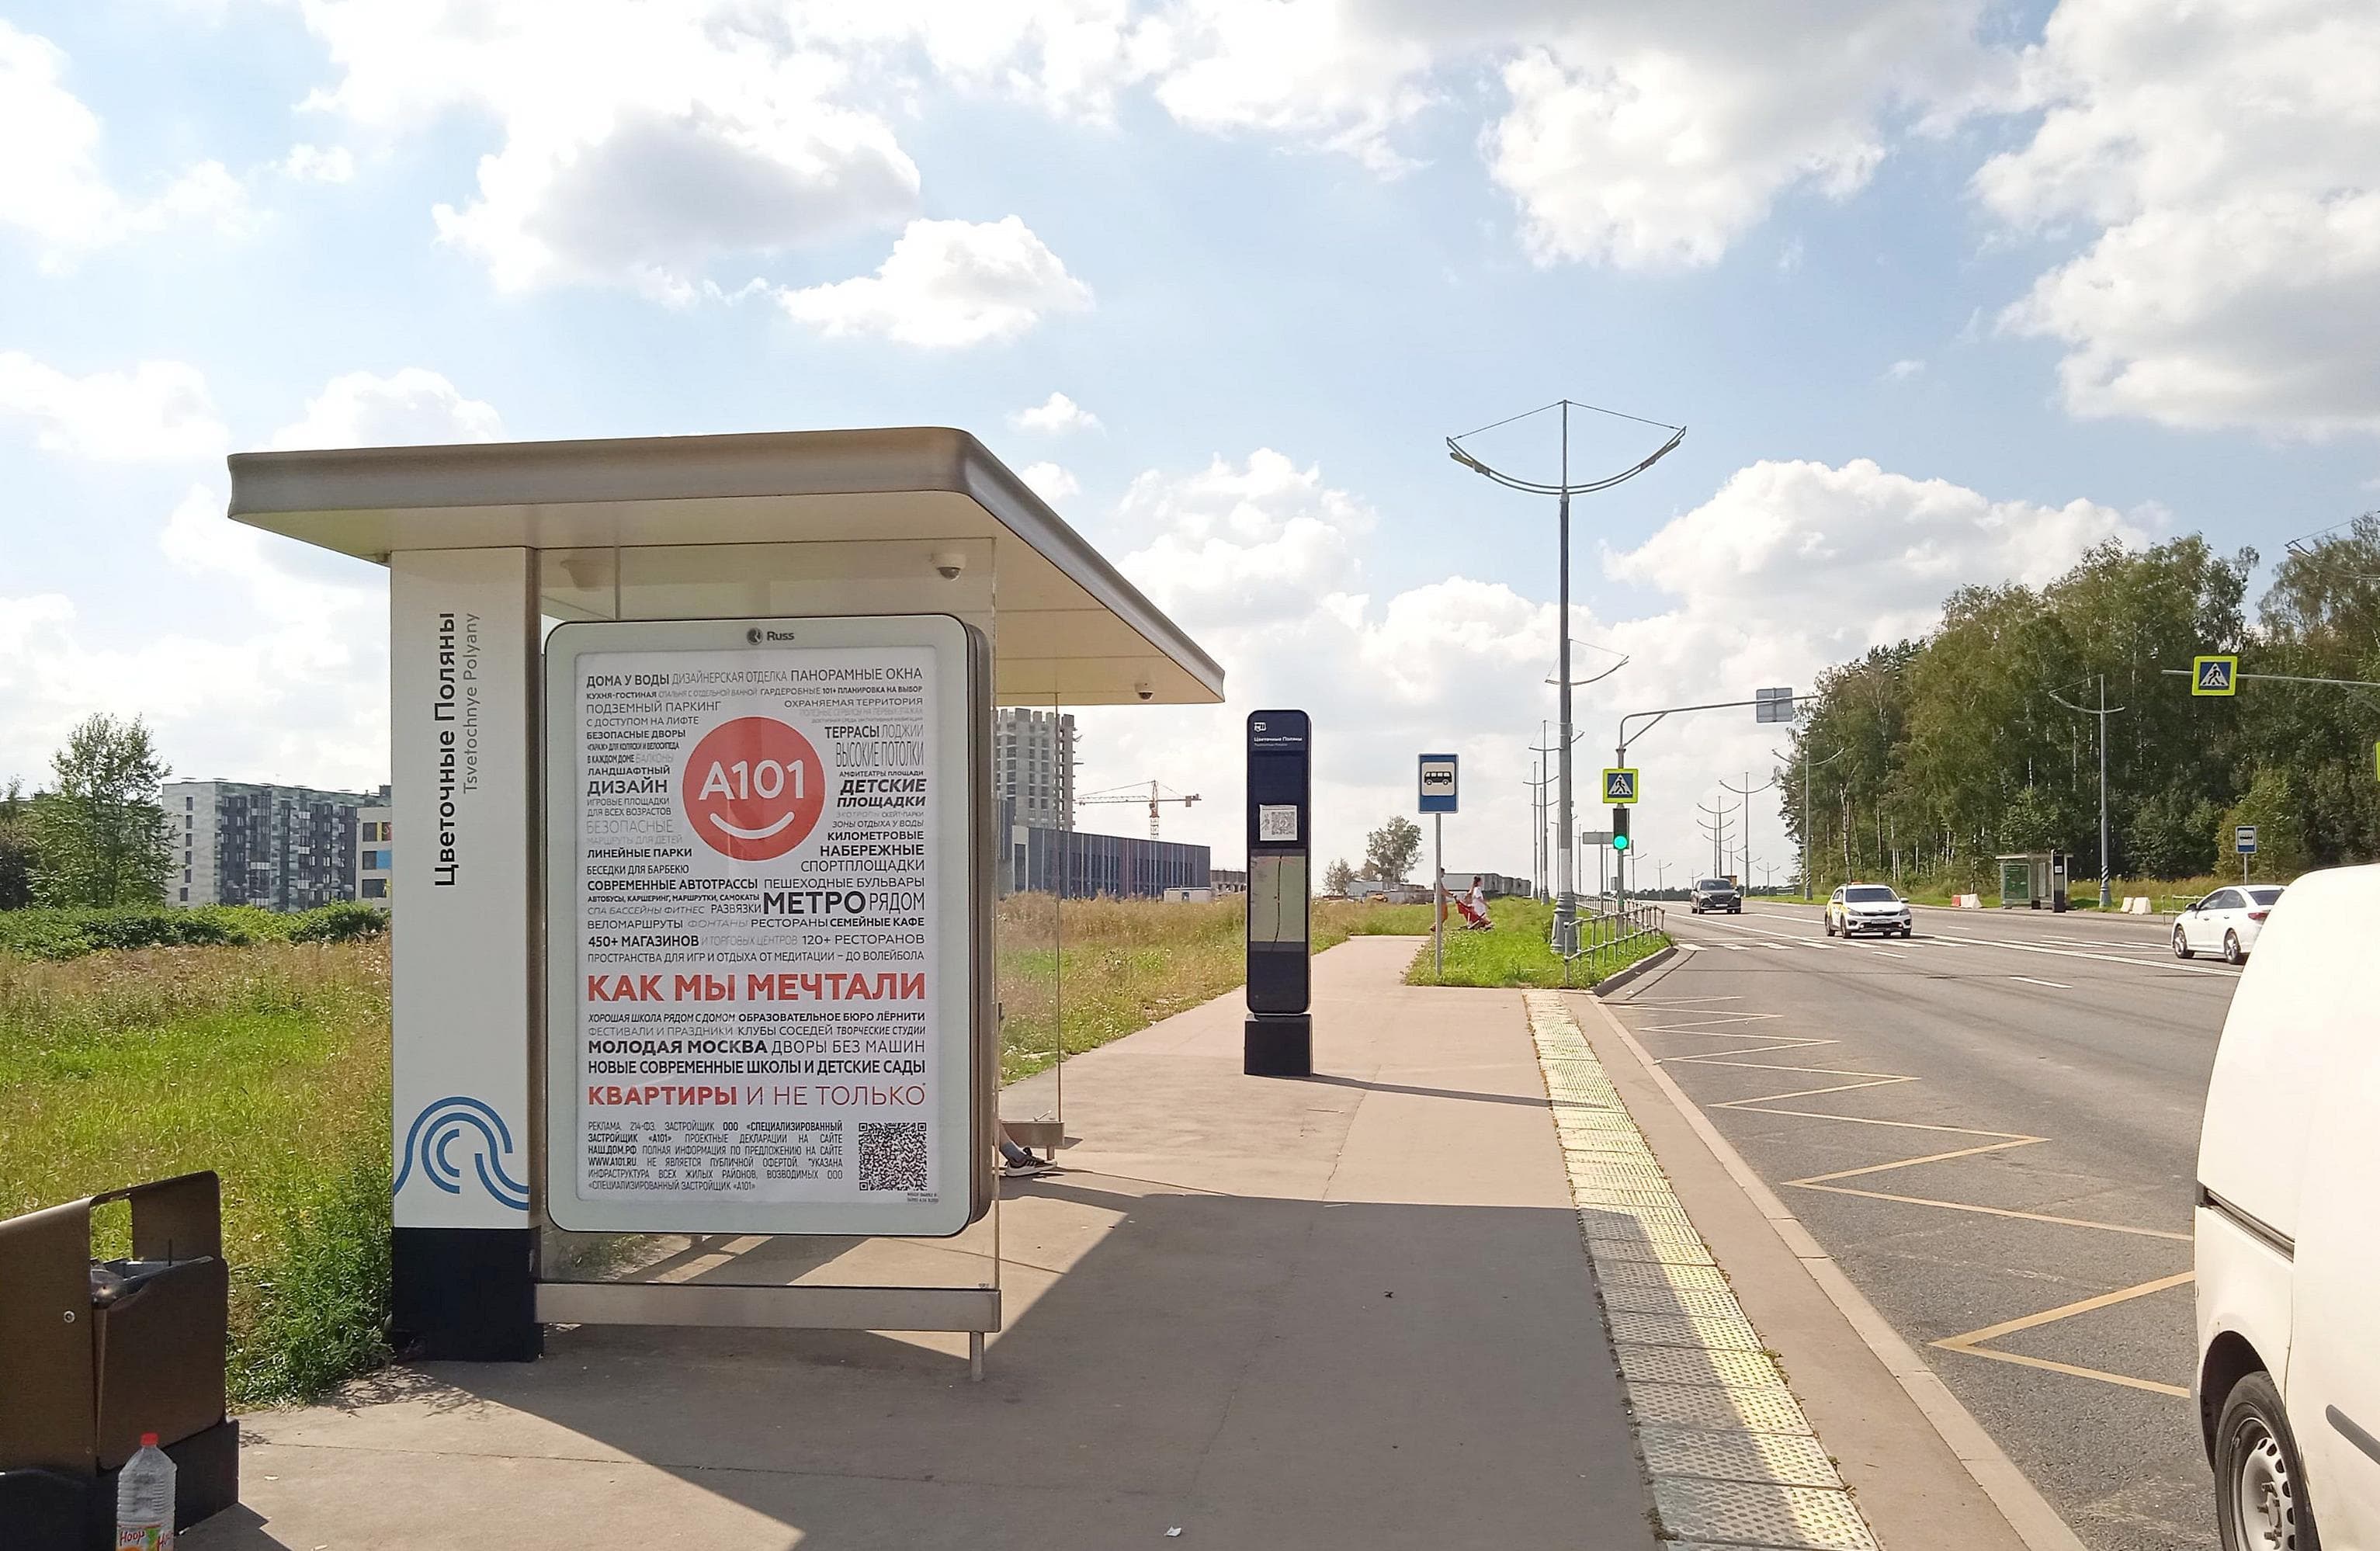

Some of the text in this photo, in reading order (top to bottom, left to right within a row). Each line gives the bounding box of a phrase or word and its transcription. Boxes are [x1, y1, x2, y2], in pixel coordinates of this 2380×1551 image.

[766, 630, 795, 641] Russ
[587, 668, 923, 689] ДОМА У ВОДЫ ДИЗАЙНЕРСКАЯ ОТДЕЛКА ПАНОРАМНЫЕ ОКНА
[587, 691, 657, 699] КУХНЯ-ГОСТИНАЯ
[761, 687, 821, 696] ГАРДЕРОБНЫЕ
[838, 686, 885, 695] ПЛАНИРОВКА
[463, 613, 481, 793] Tsvetochnye Polyany
[587, 701, 721, 715] ПОДЗЕМНЫЙ ПАРКИНГ
[784, 699, 853, 708] ОХРАНЯЕМАЯ
[595, 717, 648, 728] ДОСТУПОМ
[651, 717, 664, 726] НА
[666, 716, 699, 725] ЛИФТЕ
[587, 730, 686, 740] БЕЗОПАСНЫЕ ДВОРЫ
[824, 724, 924, 739] ТЕРРАСЫ ЛОДЖИИ
[435, 612, 459, 886] Цветочные Поляны
[837, 741, 924, 768] ВЫСОКИЕ ПОТОЛКИ
[588, 765, 670, 776] ЛАНДШАФТНЫЙ
[587, 776, 668, 796] ДИЗАЙН
[699, 760, 803, 800] А101
[840, 779, 927, 796] ДЕТСКИЕ
[624, 798, 670, 807] ПЛОЩАДКИ
[837, 796, 925, 809] ПЛОЩАДКИ
[588, 809, 603, 817] ДЛЯ
[626, 807, 671, 816] ВОЗРАСТОВ
[587, 819, 674, 834] БЕЗОПАСНЫЕ
[857, 820, 891, 828] ОТДЫХА
[655, 834, 682, 845] ДЕТЕЙ
[827, 831, 925, 841] КИЛОМЕТРОВЫЕ
[587, 848, 692, 859] ЛИНЕЙНЫЕ ПАРКИ
[820, 845, 925, 857] НАБЕРЕЖНЫЕ
[587, 865, 689, 876] БЕСЕДКИ ДЛЯ БАРБЕКЮ
[801, 859, 925, 873] СПОРТПЛОЩАДКИ
[588, 877, 925, 891] СОВРЕМЕННЫЕ АВТОТРАССЫ ПЕШЕХОДНЫЕ БУЛЬВАРЫ
[672, 894, 718, 903] МАРШРУТКИ,
[764, 890, 925, 914] МЕТРО РЯДОМ
[588, 904, 762, 915] СПА БАССЕЙНЫ ФИТНЕС РАЗВЯЗКИ
[588, 916, 925, 929] ВЕЛОМАРШРУТЫ ФОНТАНЫ РЕСТОРАНЫ СЕМЕЙНЫЕ КАФЕ
[588, 935, 925, 948] 450+ МАГАЗИНОВ ЦЕНТРОВ 120+ РЕСТОРАНОВ
[588, 949, 925, 963] ПРОСТРАНСТВА ДЛЯ ИГР И ОТДЫХА ОТ МЕДИТАЦИИ ДО ВОЛЕЙБОЛА
[588, 973, 925, 1001] КАК МЫ МЕЧТАЛИ
[588, 1011, 925, 1024] ХОРОШАЯ ШКОЛА РЯДОМ С ДОМОМ ОБРАЗОВАТЕЛЬНОЕ БЮРО ЛЁРНИТИ
[588, 1025, 925, 1036] ФЕСТИВАЛИ И ПРАЗДНИКИ КЛУБЫ СОСЕДЕЙ ТВОРЧЕСКИЕ СТУДИИ
[588, 1040, 925, 1057] МОЛОДАЯ МОСКВА ДВОРЫ БЕЗ МАШИН
[588, 1060, 925, 1076] НОВЫЕ СОВРЕМЕННЫЕ ШКОЛЫ И ДЕТСКИЕ САДЫ
[588, 1086, 737, 1105] КВАРТИРЫ
[747, 1086, 764, 1105] И
[775, 1086, 808, 1105] НЕ
[664, 1119, 843, 1132] ЗАСТРОЙЩИК ООО «СПЕЦИАЛИЗИРОВАННЫЙ
[588, 1132, 843, 1144] ЗАСТРОЙЩИК ПРОЕКТНЫЕ ДЕКЛАРАЦИИ НА САЙТЕ
[643, 1144, 843, 1156] ПОЛНАЯ ИНФОРМАЦИЯ ПО ПРЕДЛОЖЕНИЮ НА САЙТЕ
[647, 1156, 754, 1167] НЕ ЯВЛЯЕТСЯ ПУБЛИЧНОЙ
[588, 1168, 843, 1180] ИНФРАСТРУКТУРА ВСЕХ ЖИЛЫХ РАЙОНОВ, ВОЗВОДИМЫХ ООО
[588, 1180, 731, 1191] «СПЕЦИАЛИЗИРОВАННЫЙ ЗАСТРОЙЩИК
